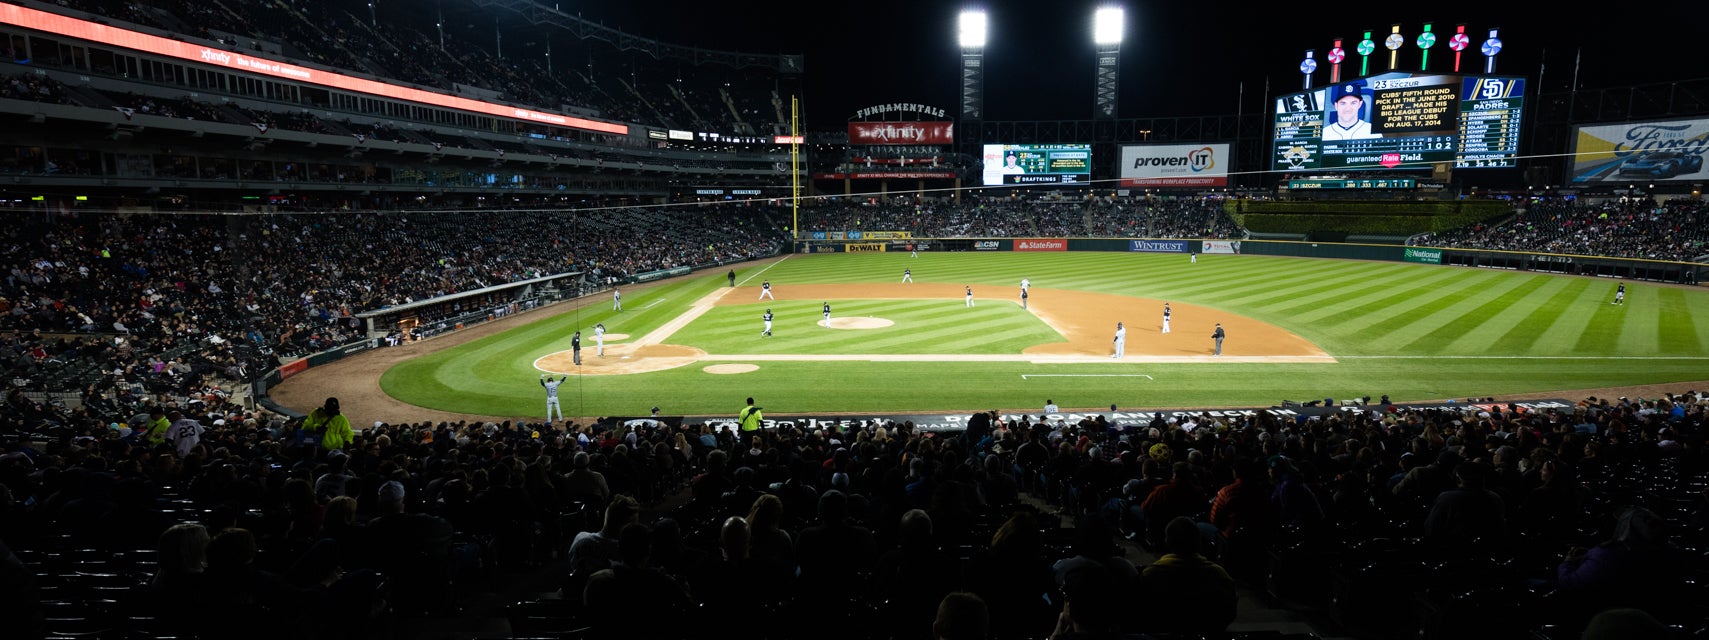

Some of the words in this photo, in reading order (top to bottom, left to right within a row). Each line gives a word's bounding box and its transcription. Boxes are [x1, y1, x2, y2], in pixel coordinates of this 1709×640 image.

[856, 103, 945, 118] FUNDAMENTALS
[1474, 102, 1509, 110] PADRES
[878, 125, 924, 141] xfinity
[1134, 157, 1188, 168] proven
[1196, 155, 1208, 165] IT
[1413, 250, 1440, 258] National
[180, 426, 195, 437] 23
